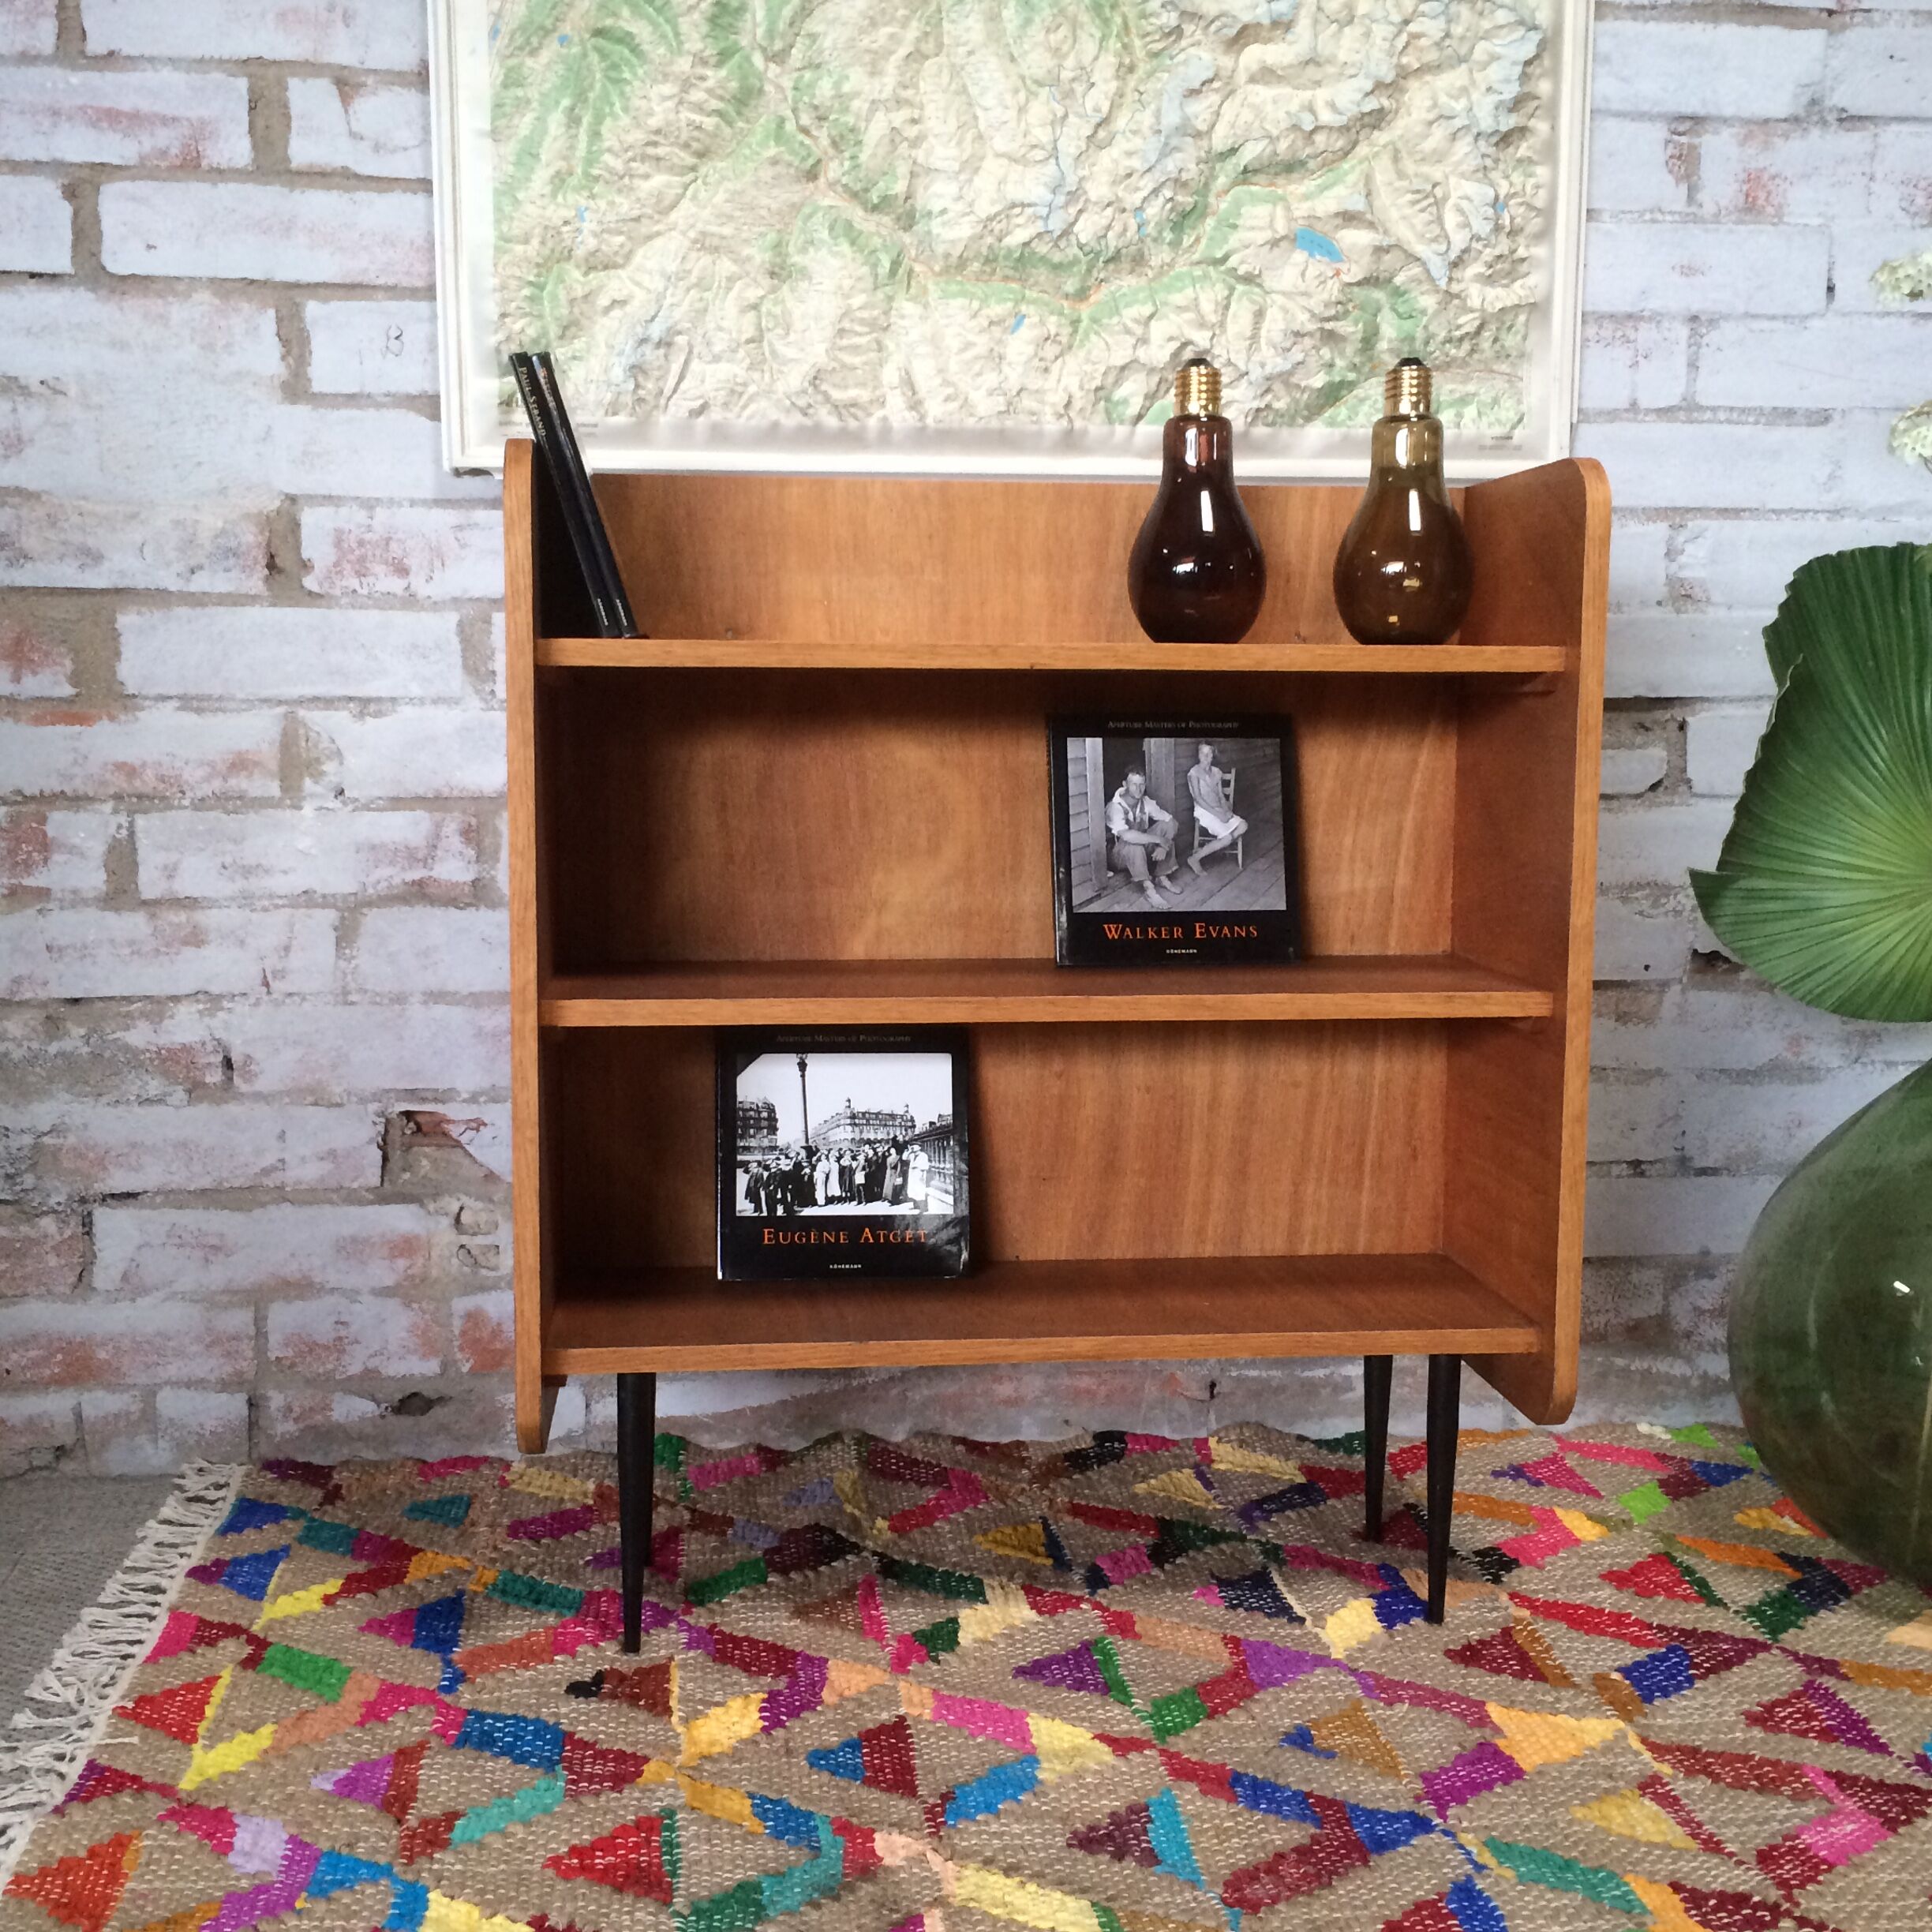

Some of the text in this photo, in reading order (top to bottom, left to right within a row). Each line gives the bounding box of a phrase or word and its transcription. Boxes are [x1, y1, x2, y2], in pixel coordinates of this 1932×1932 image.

[519, 366, 532, 391] PAUL
[1103, 923, 1258, 941] WALKER EVANS
[762, 1227, 928, 1245] EUGÈNE ATGET
